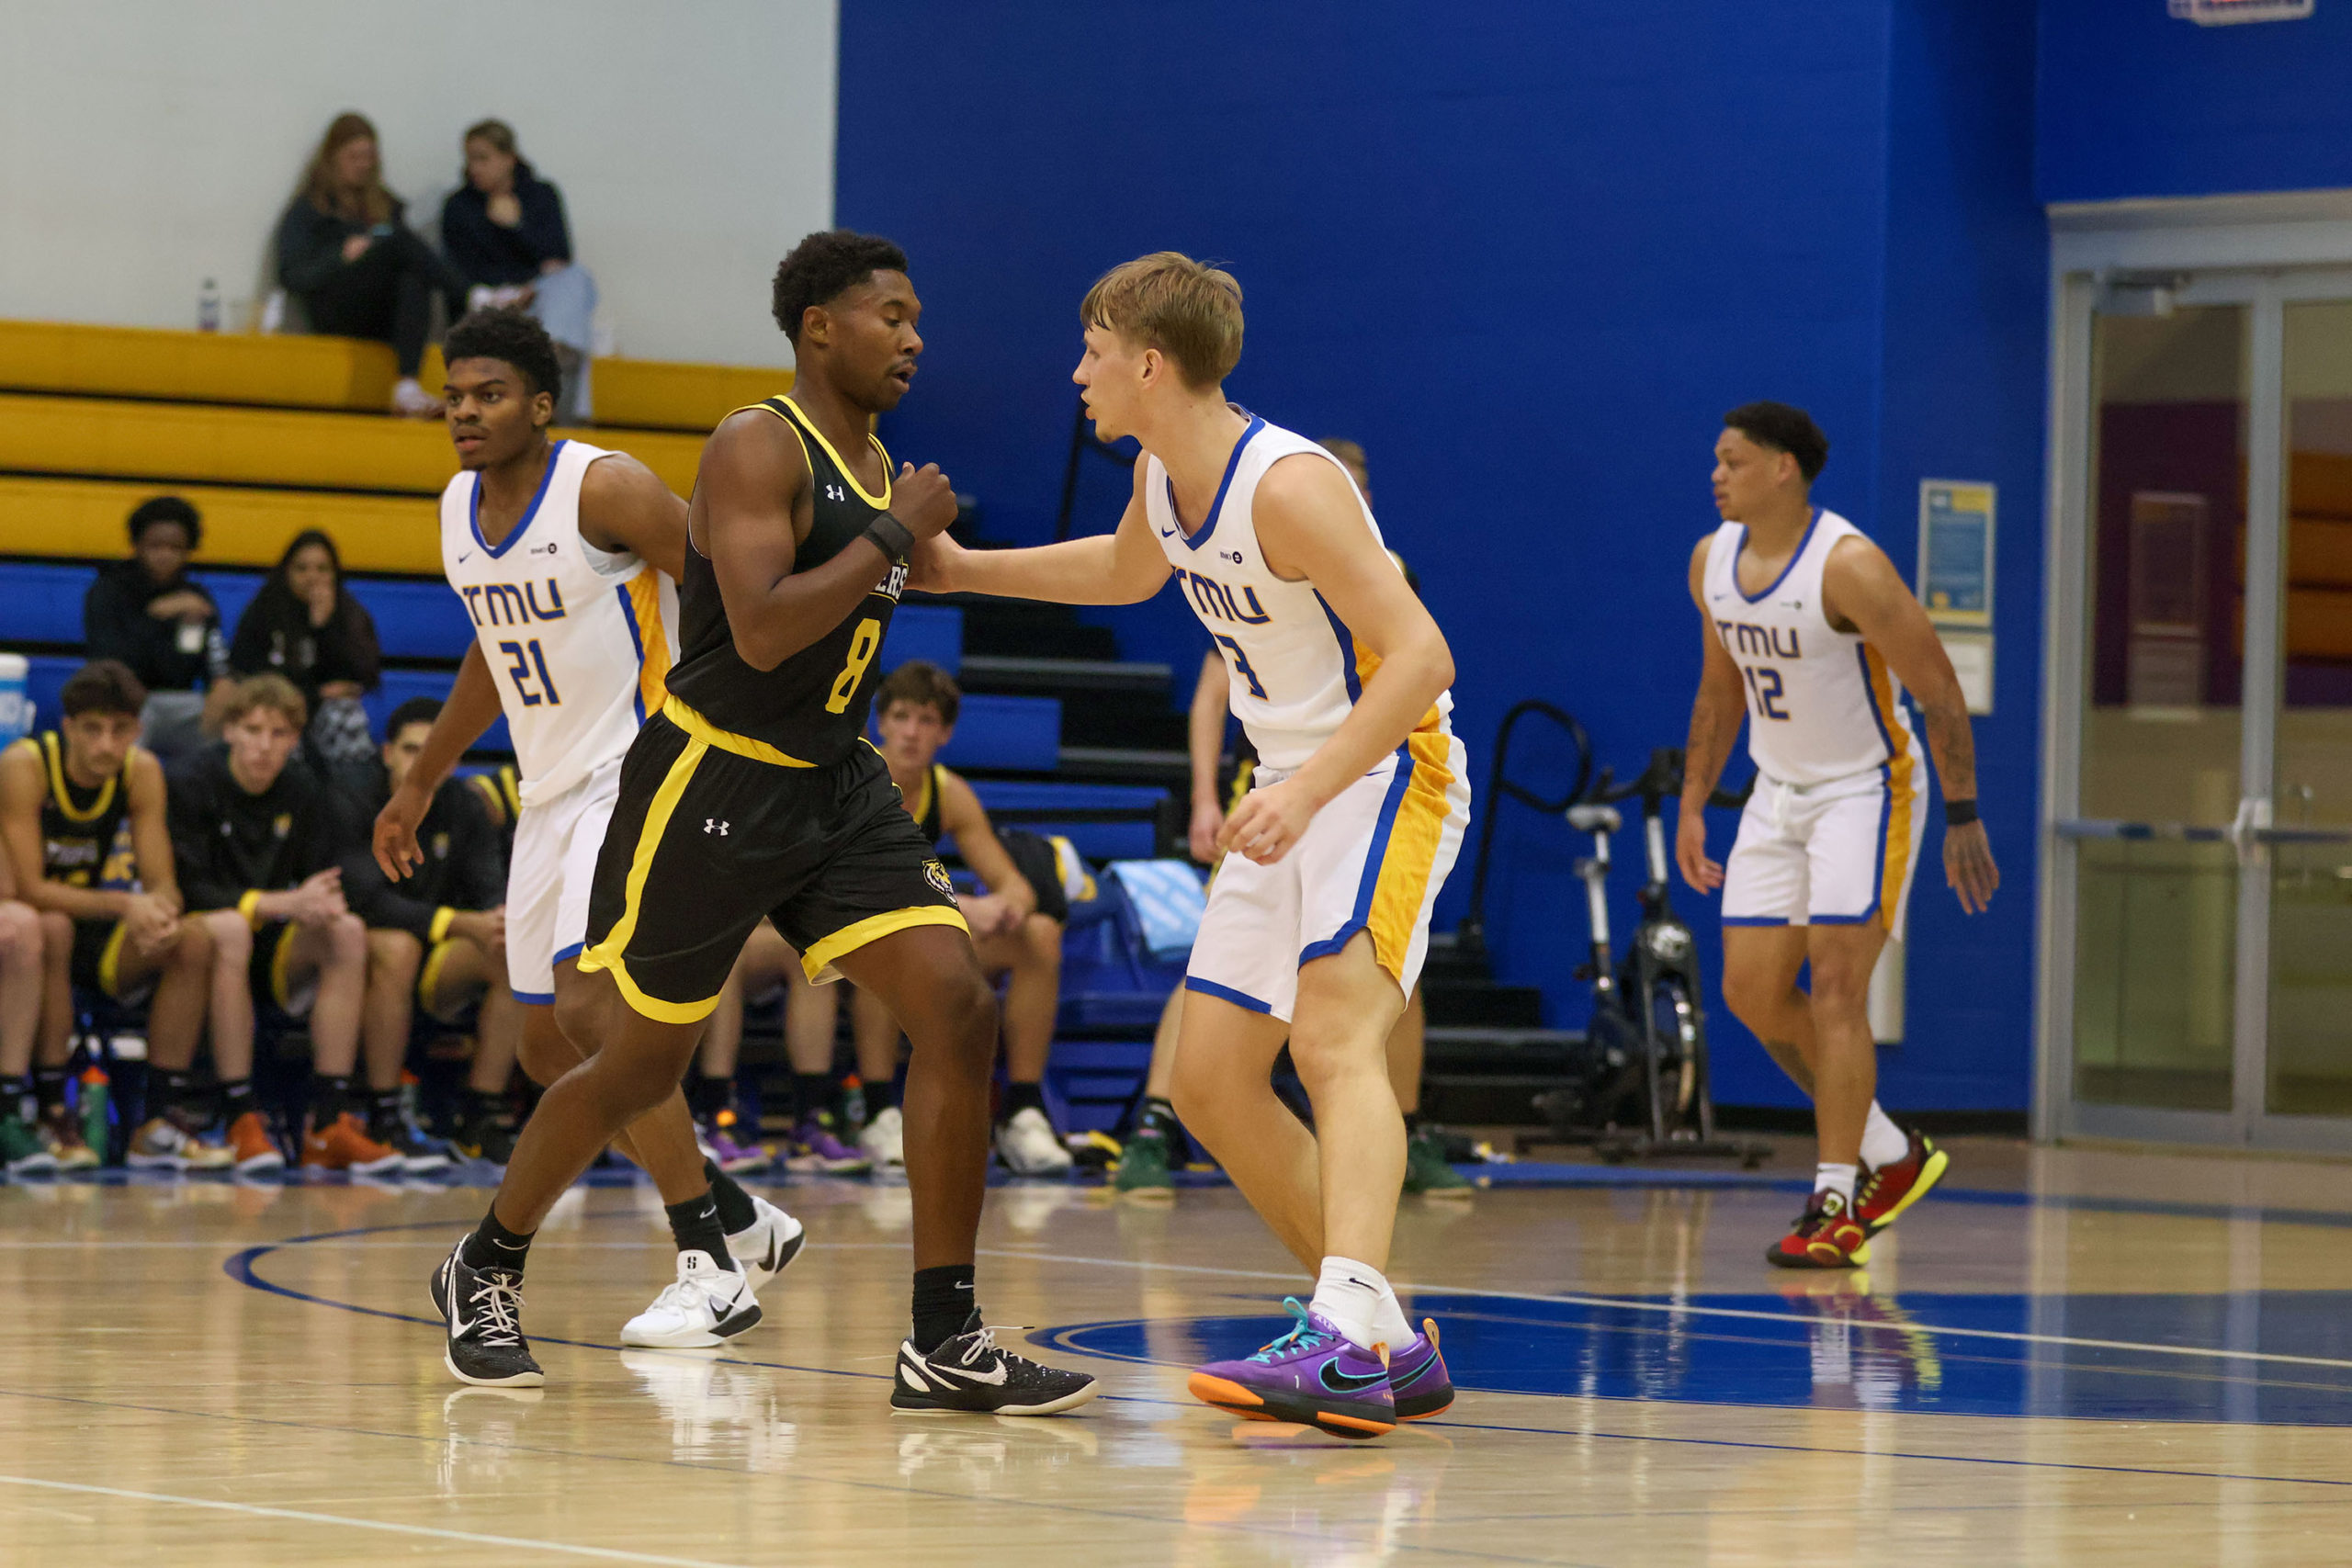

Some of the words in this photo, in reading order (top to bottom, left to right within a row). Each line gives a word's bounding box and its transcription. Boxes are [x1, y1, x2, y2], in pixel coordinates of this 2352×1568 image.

[462, 577, 567, 627] TMU
[825, 617, 881, 715] 8
[1716, 619, 1802, 660] TMU
[498, 637, 562, 707] 21
[1745, 665, 1790, 721] 12
